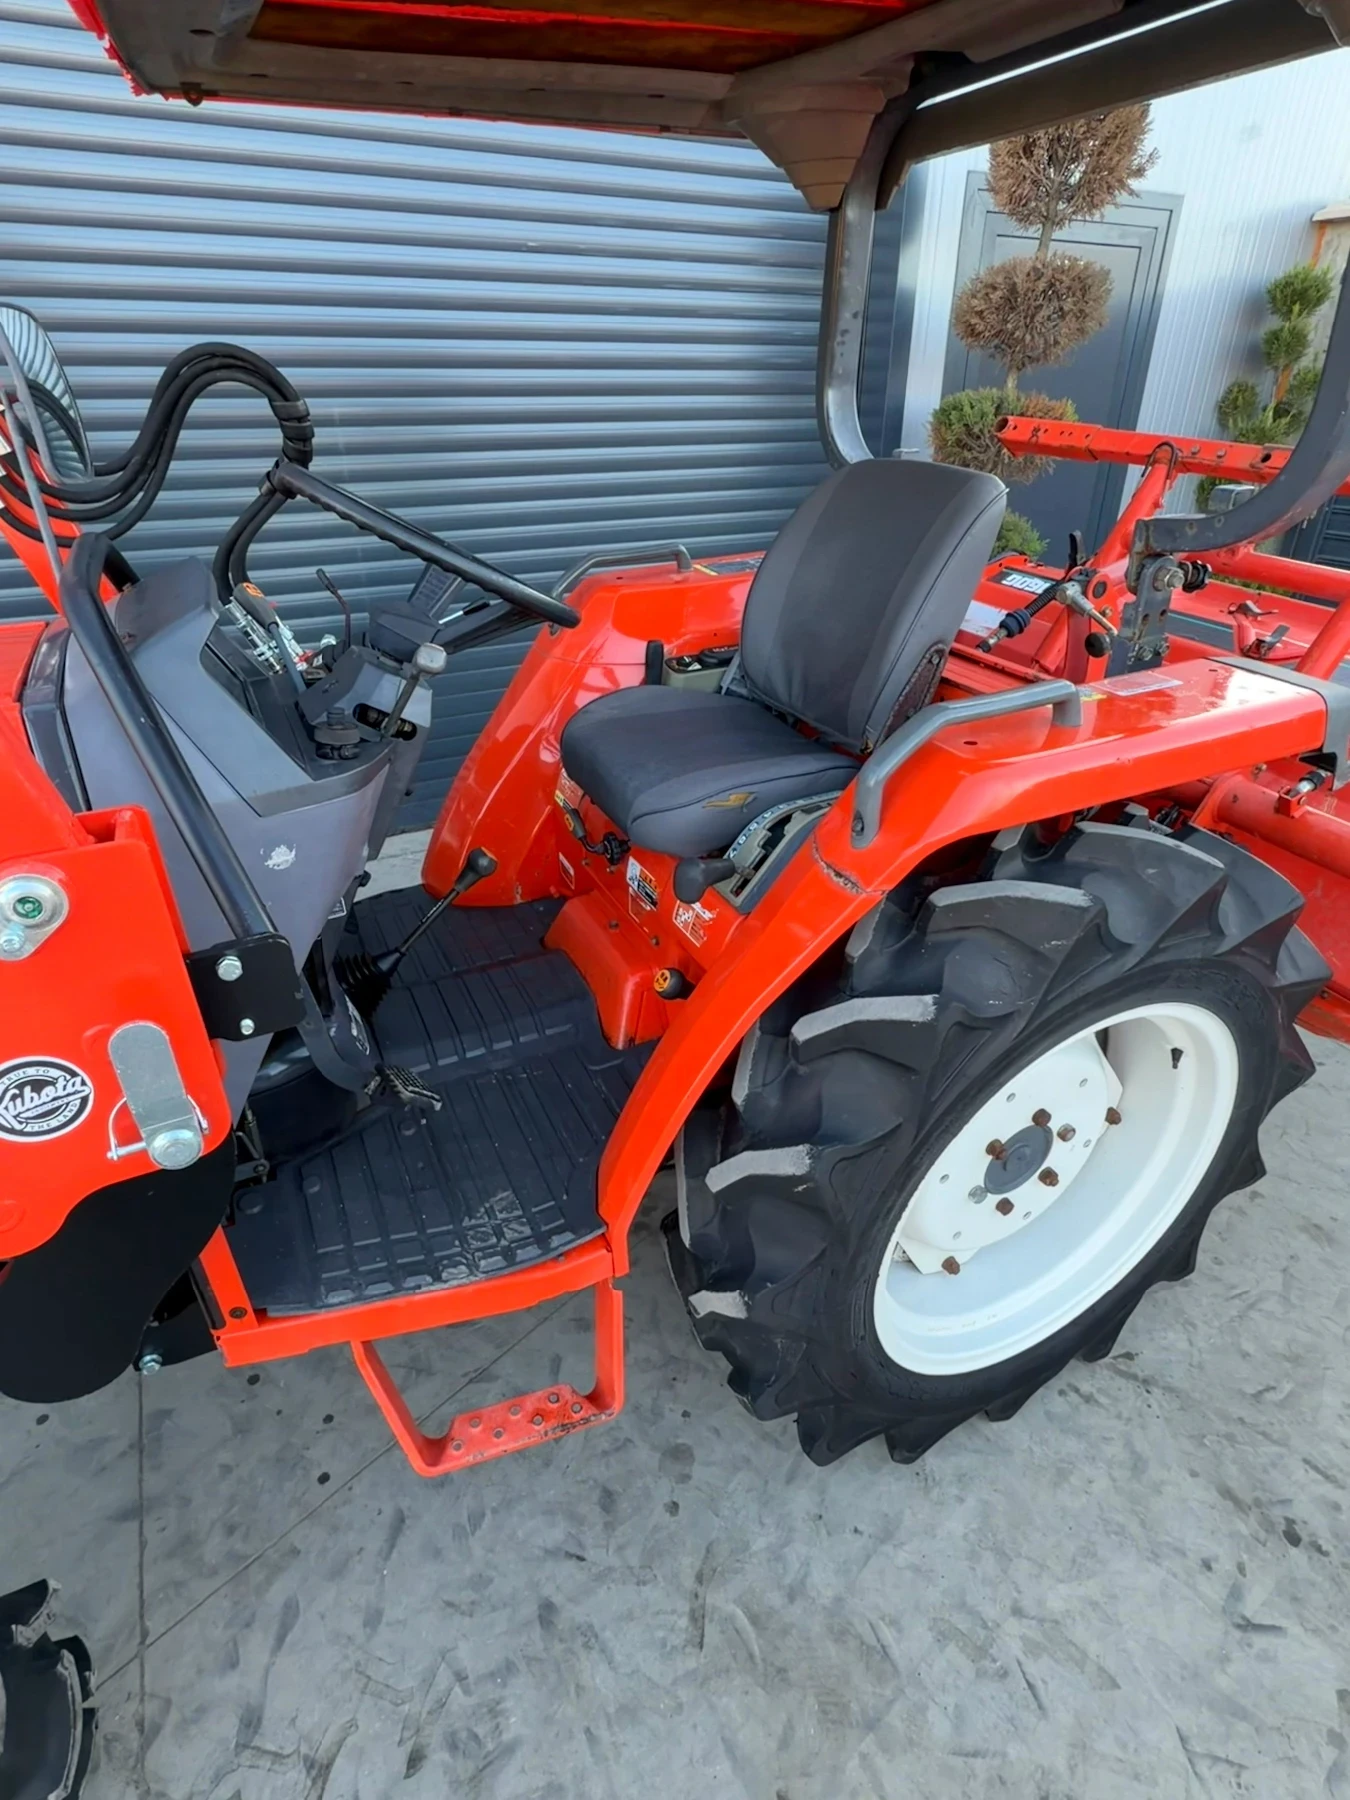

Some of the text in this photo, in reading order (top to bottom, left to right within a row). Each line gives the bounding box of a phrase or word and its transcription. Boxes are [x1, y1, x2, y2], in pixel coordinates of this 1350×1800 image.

[0, 1069, 29, 1086] TRUE
[0, 1075, 85, 1131] Kubota
[30, 1122, 52, 1131] THE
[56, 1102, 78, 1123] LAND
